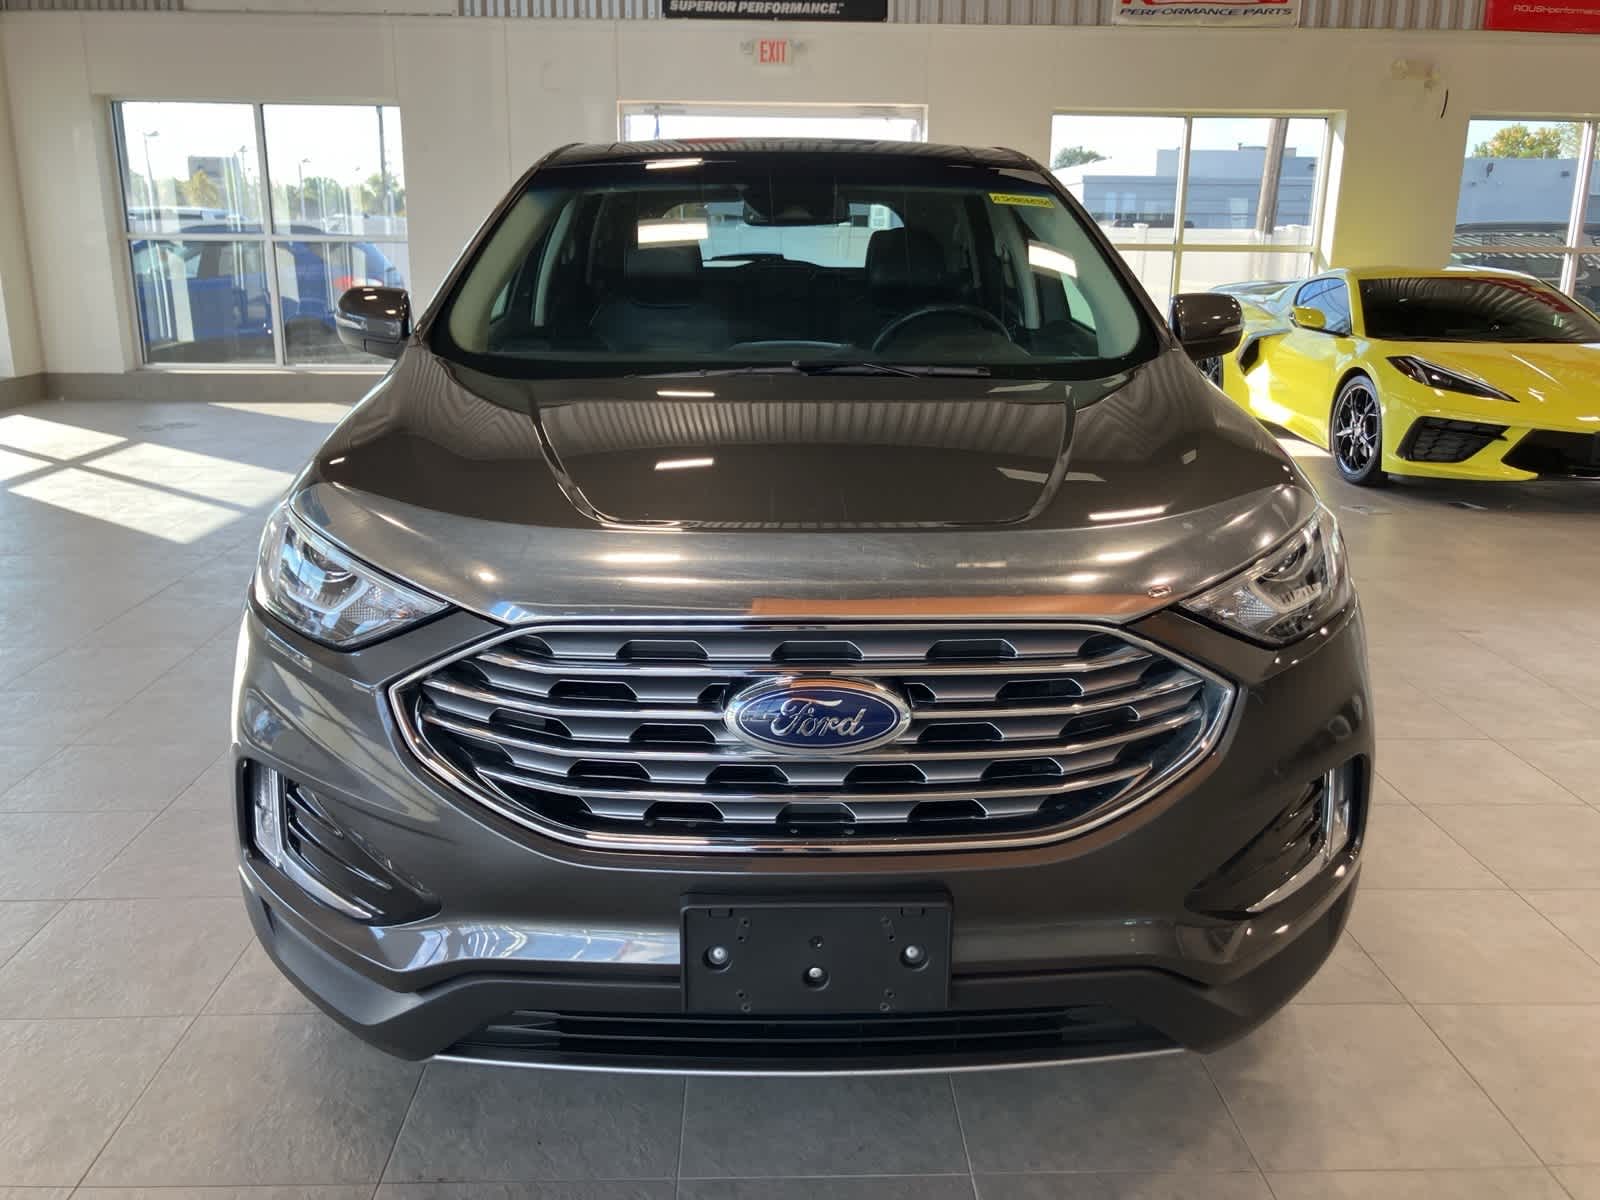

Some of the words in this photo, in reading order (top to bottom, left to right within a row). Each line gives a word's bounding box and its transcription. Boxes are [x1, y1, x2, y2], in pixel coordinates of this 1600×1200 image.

[669, 0, 736, 12] SUPERIOR
[1120, 7, 1239, 16] PERFORMANCE
[1243, 7, 1292, 16] PARTS
[759, 40, 786, 63] EXIT
[771, 697, 867, 736] Ford
